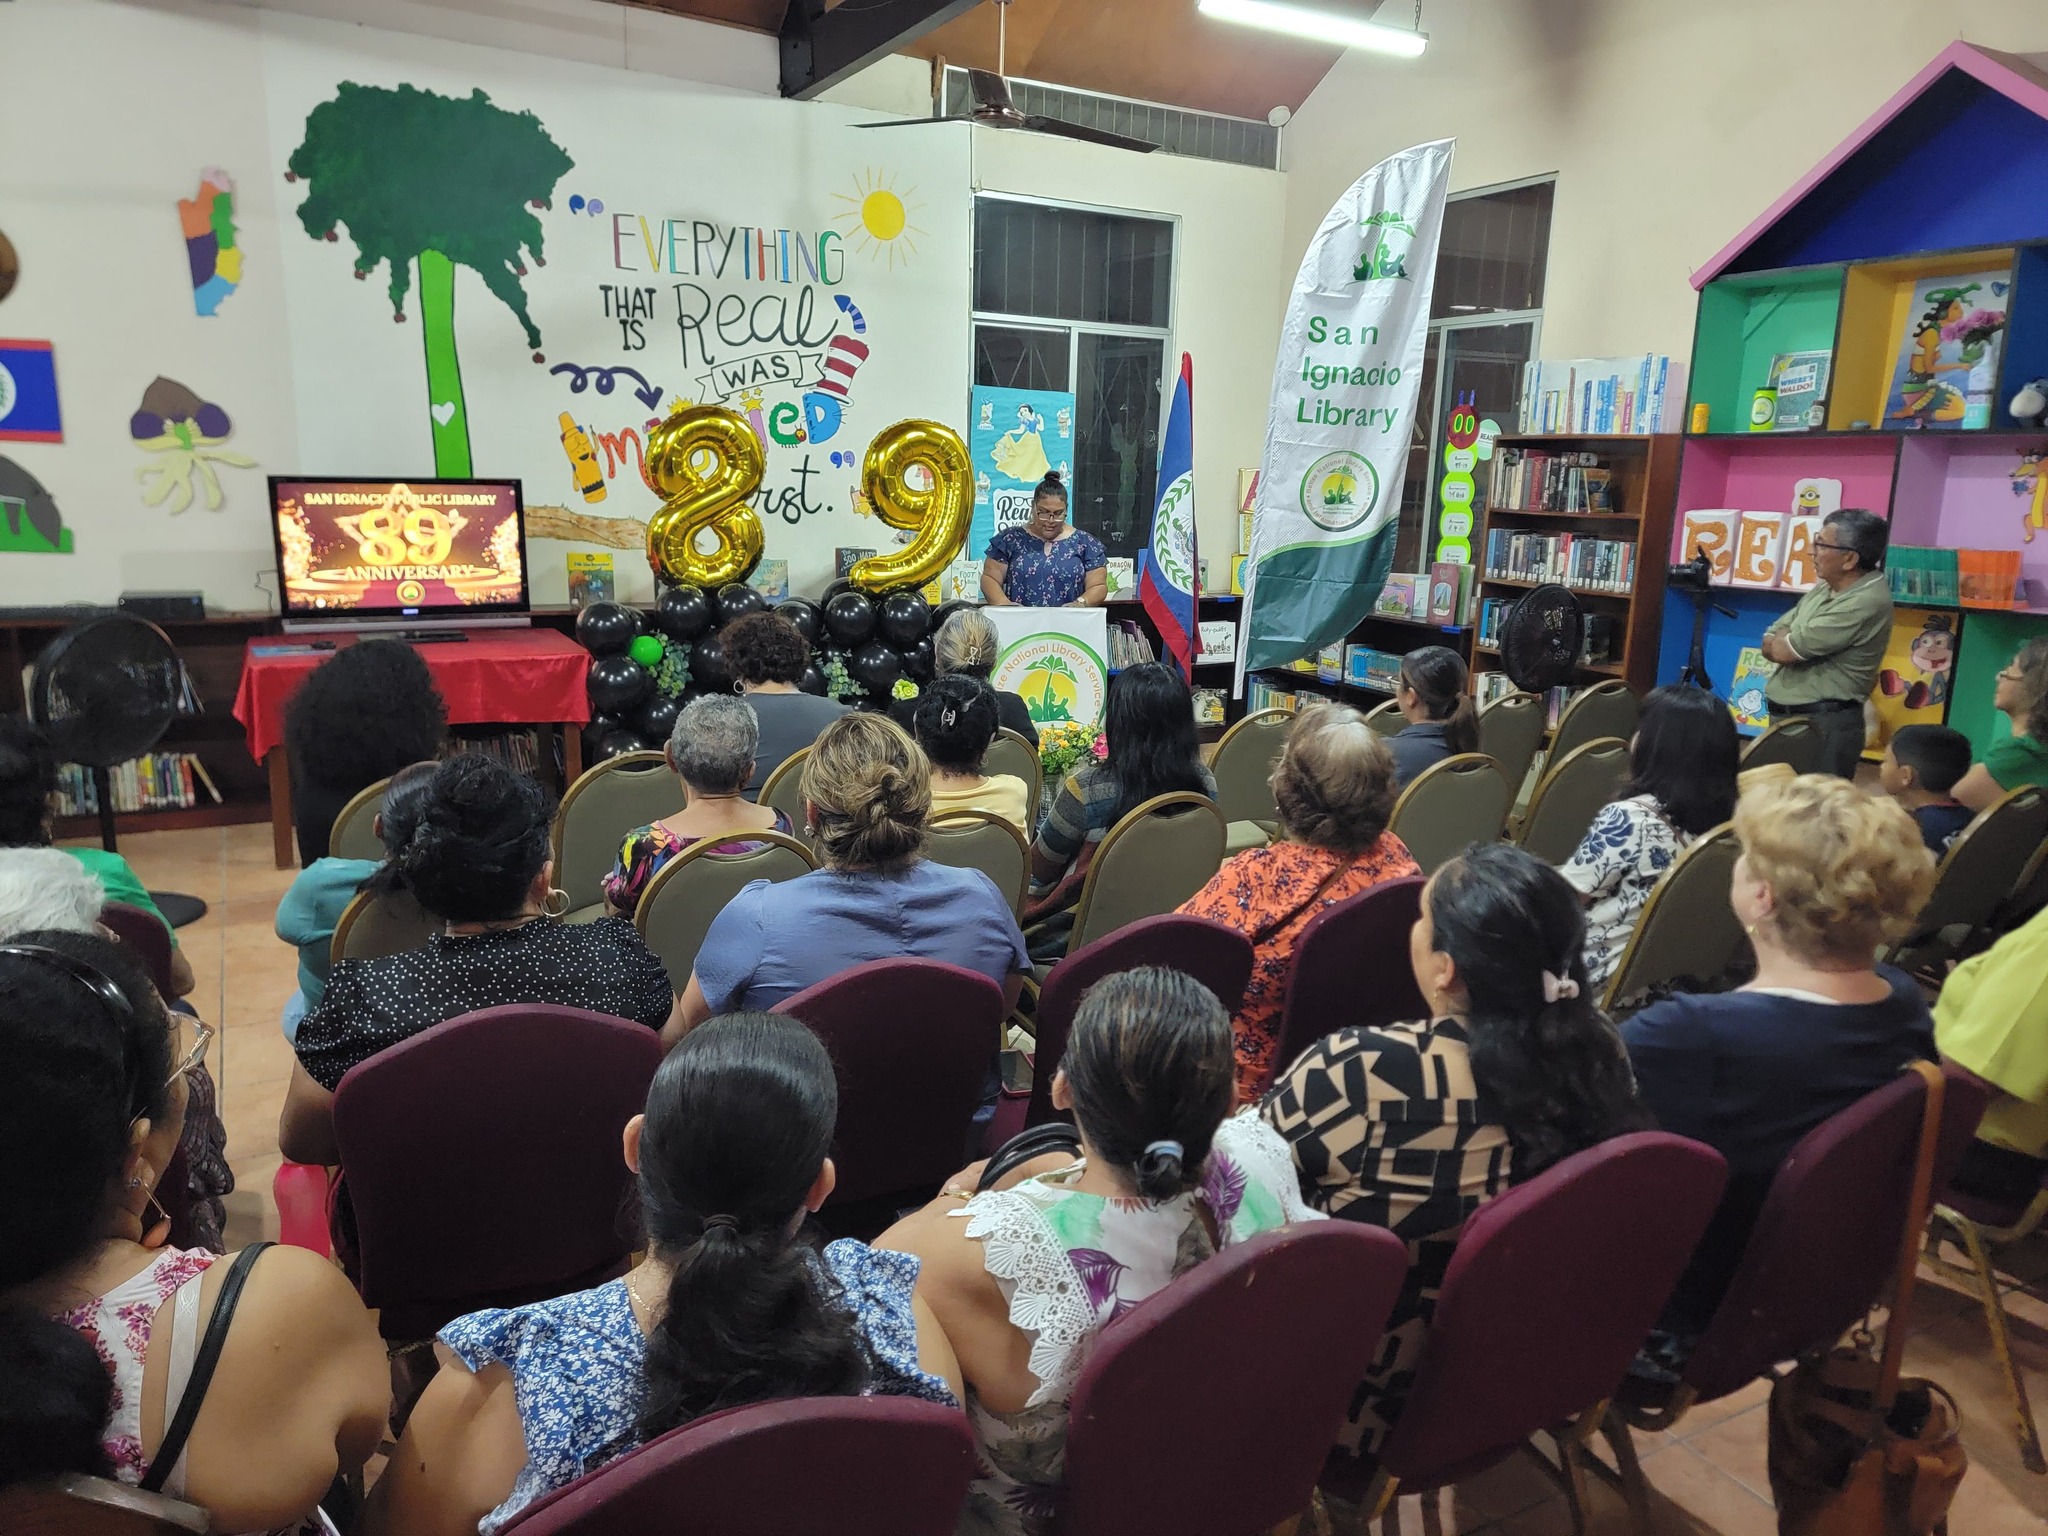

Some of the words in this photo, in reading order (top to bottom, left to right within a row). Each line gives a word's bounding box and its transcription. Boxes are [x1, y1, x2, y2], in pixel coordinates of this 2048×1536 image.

[612, 212, 845, 286] EVERYTHING
[599, 284, 657, 319] THAT
[619, 318, 646, 351] IS
[673, 283, 839, 369] Real
[1307, 315, 1379, 345] San
[721, 355, 791, 389] WAS
[1301, 356, 1402, 391] Ignacio
[1296, 397, 1400, 434] Library
[303, 492, 334, 505] SAN
[334, 493, 392, 505] IGNACIO
[442, 495, 497, 506] LIBRARY
[646, 405, 767, 588] 8
[849, 418, 975, 592] 9
[997, 495, 1031, 521] Rea
[359, 507, 453, 565] 89
[1685, 516, 1818, 586] REA
[345, 564, 475, 581] ANNIVERSARY
[843, 553, 857, 566] 500
[1004, 643, 1049, 672] National
[1051, 643, 1087, 666] Library
[1085, 665, 1102, 707] Service
